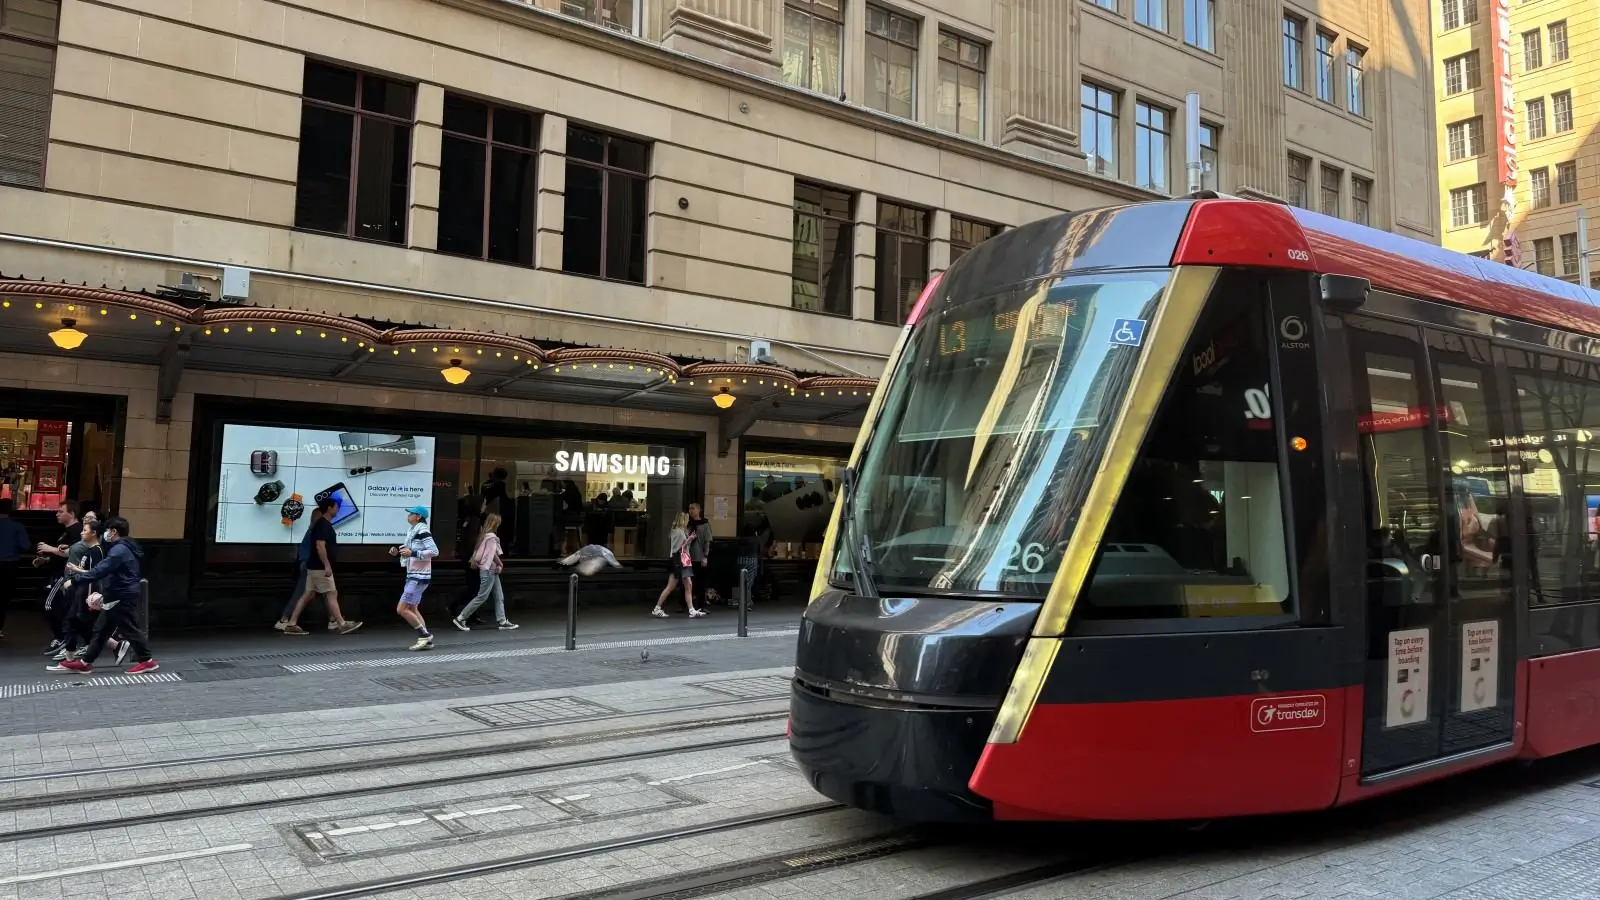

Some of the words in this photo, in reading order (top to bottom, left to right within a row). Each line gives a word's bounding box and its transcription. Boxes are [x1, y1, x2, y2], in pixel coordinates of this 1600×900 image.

[1287, 248, 1309, 261] 026
[940, 320, 967, 357] L3
[1281, 342, 1311, 350] ALSTOM
[554, 450, 671, 476] SAMSUNG
[1006, 541, 1045, 574] 26
[1467, 629, 1475, 637] Tap
[1394, 637, 1403, 646] Tap
[1410, 636, 1424, 645] every
[1395, 647, 1406, 656] time
[1406, 645, 1423, 654] before
[1398, 655, 1420, 665] boarding
[1276, 707, 1320, 721] transdev
